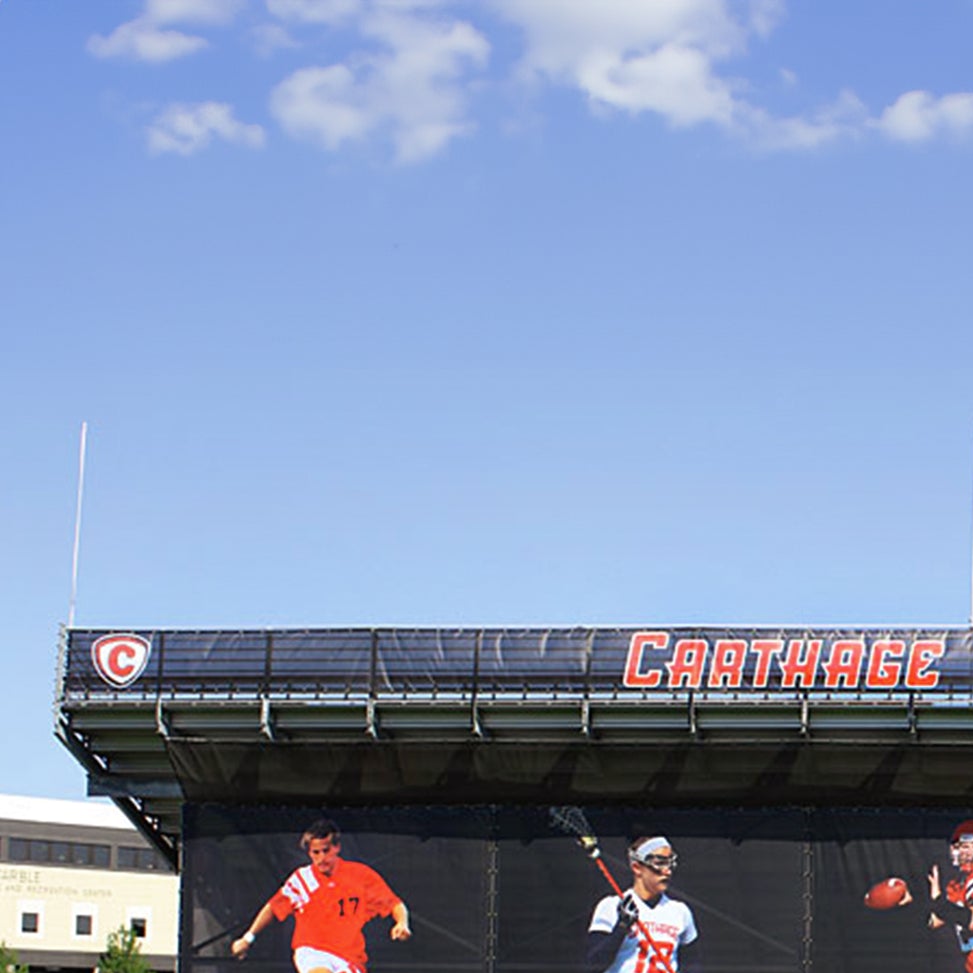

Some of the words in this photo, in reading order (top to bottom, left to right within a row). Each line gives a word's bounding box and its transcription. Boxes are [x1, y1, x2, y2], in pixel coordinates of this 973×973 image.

[108, 643, 136, 677] C
[622, 631, 947, 689] CARTHAGE
[338, 897, 360, 917] 17
